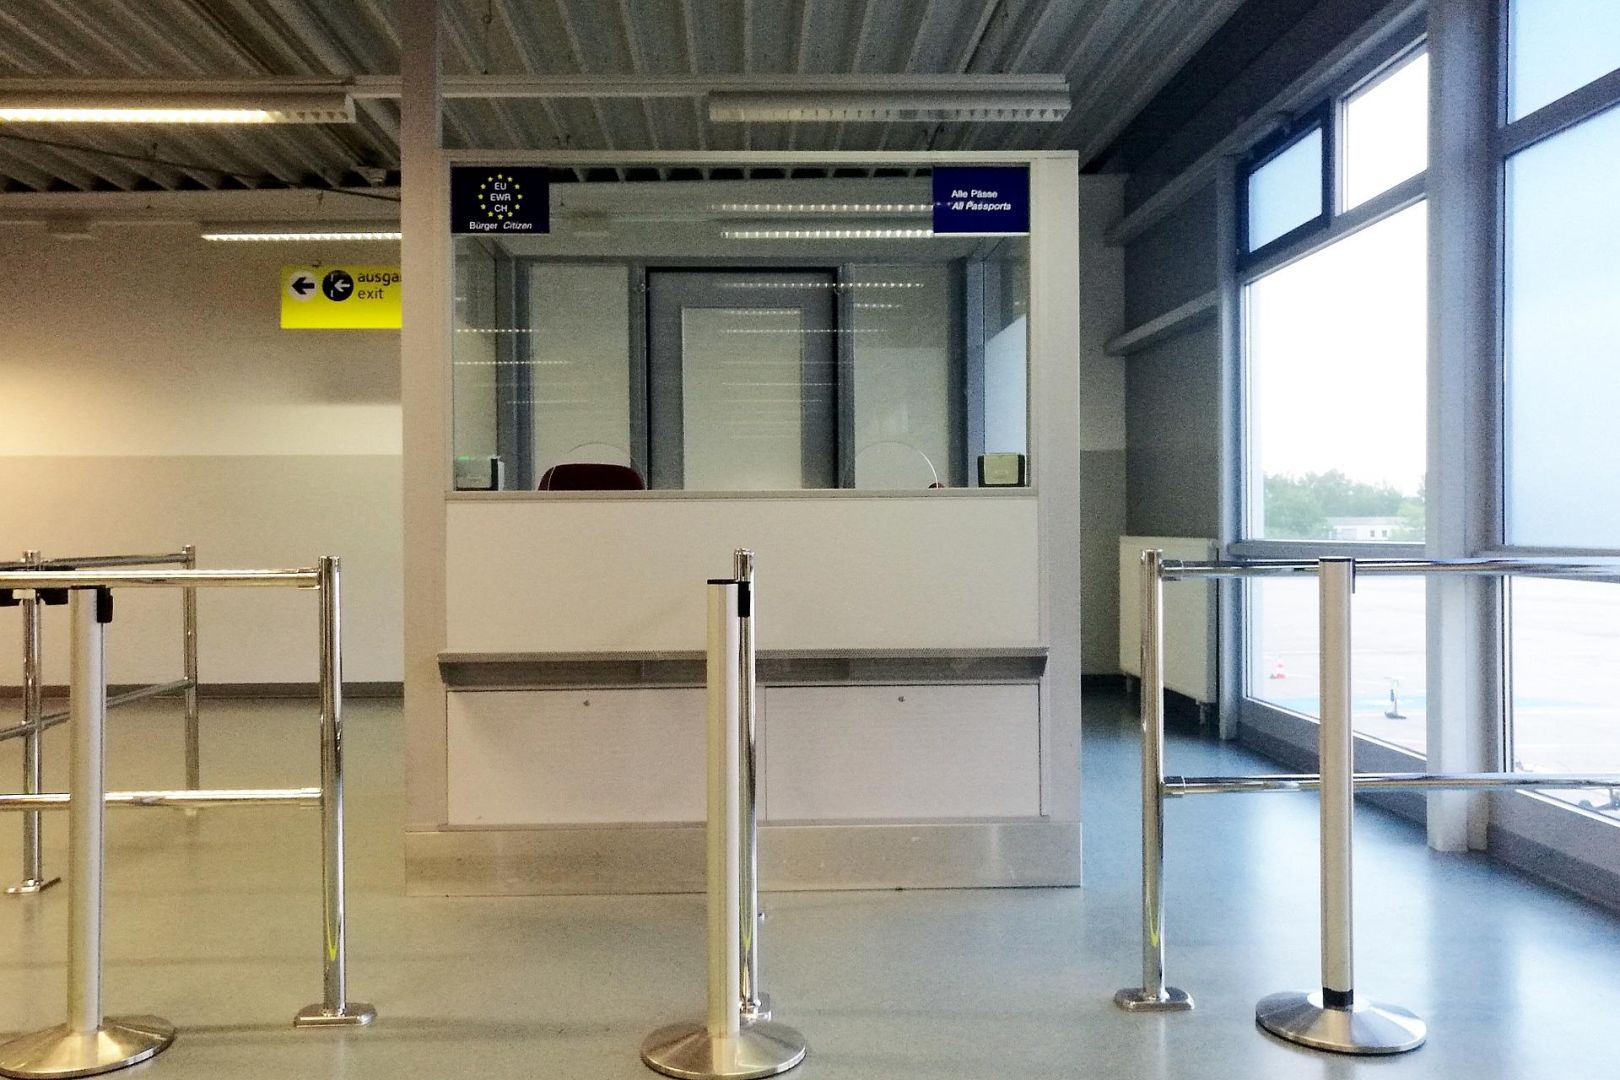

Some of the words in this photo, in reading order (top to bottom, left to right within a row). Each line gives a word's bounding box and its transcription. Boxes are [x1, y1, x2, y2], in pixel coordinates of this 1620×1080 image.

[494, 182, 507, 191] EU
[490, 193, 511, 202] EWR
[951, 189, 968, 199] Alle
[970, 189, 998, 199] Pässe
[494, 204, 508, 213] CH
[951, 201, 964, 211] All
[965, 201, 1011, 212] Passports
[469, 221, 498, 232] Bürger
[503, 221, 532, 230] Citizen
[357, 272, 401, 287] ausga
[357, 288, 384, 300] exit
